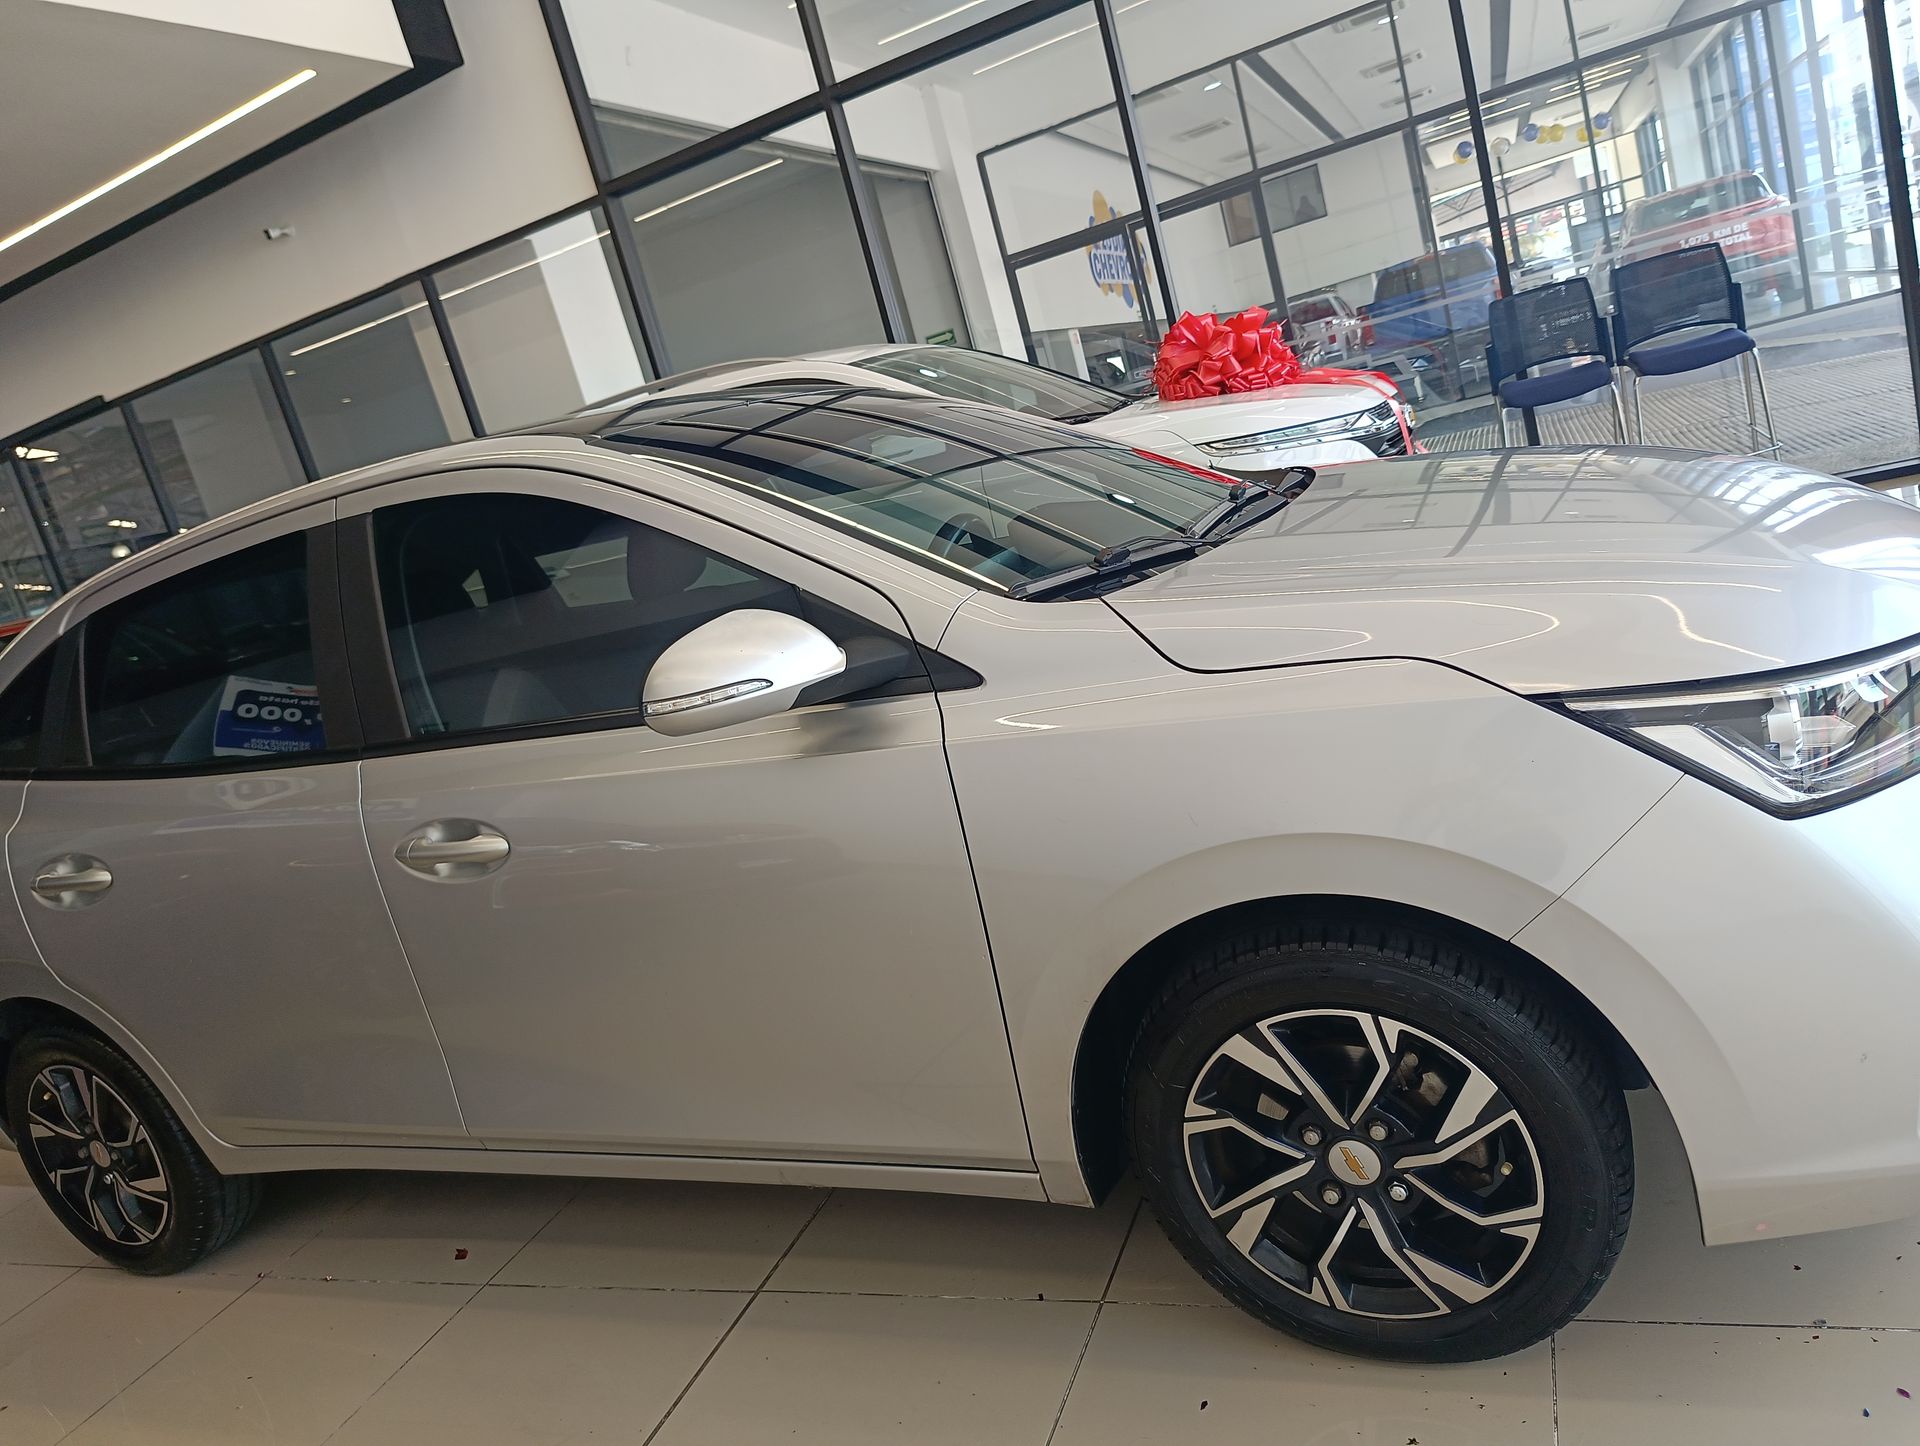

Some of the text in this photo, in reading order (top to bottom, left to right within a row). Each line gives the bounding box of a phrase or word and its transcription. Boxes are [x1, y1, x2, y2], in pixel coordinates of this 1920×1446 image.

[1713, 227, 1732, 239] KM
[1733, 222, 1749, 233] DE
[1719, 232, 1752, 247] TOTAL
[1093, 252, 1133, 280] CHEVRO
